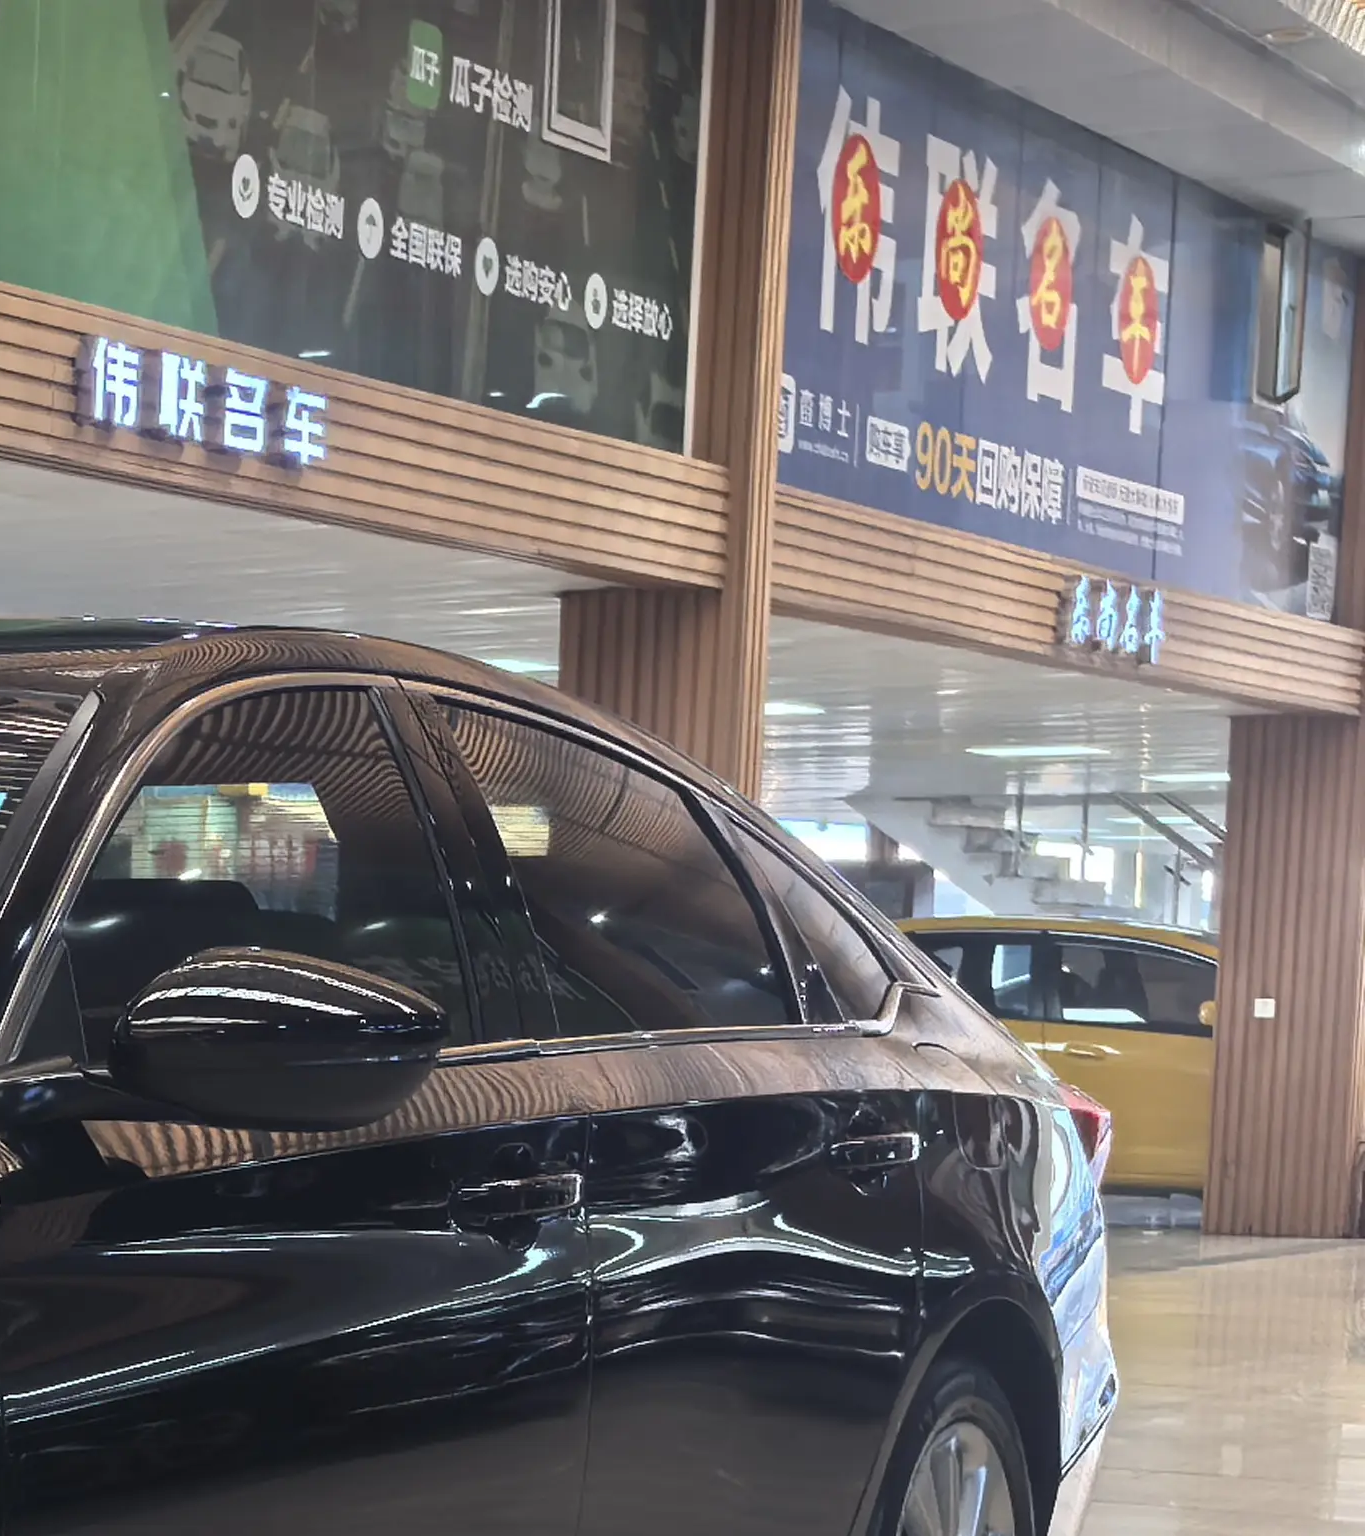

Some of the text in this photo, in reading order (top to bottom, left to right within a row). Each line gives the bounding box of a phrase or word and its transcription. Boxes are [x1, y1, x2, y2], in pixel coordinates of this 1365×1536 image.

[410, 45, 533, 132] 瓜子 瓜子检测
[267, 173, 674, 342] 专业检测 全国联保 选购安心 选择放心
[92, 337, 329, 466] 伟联名车
